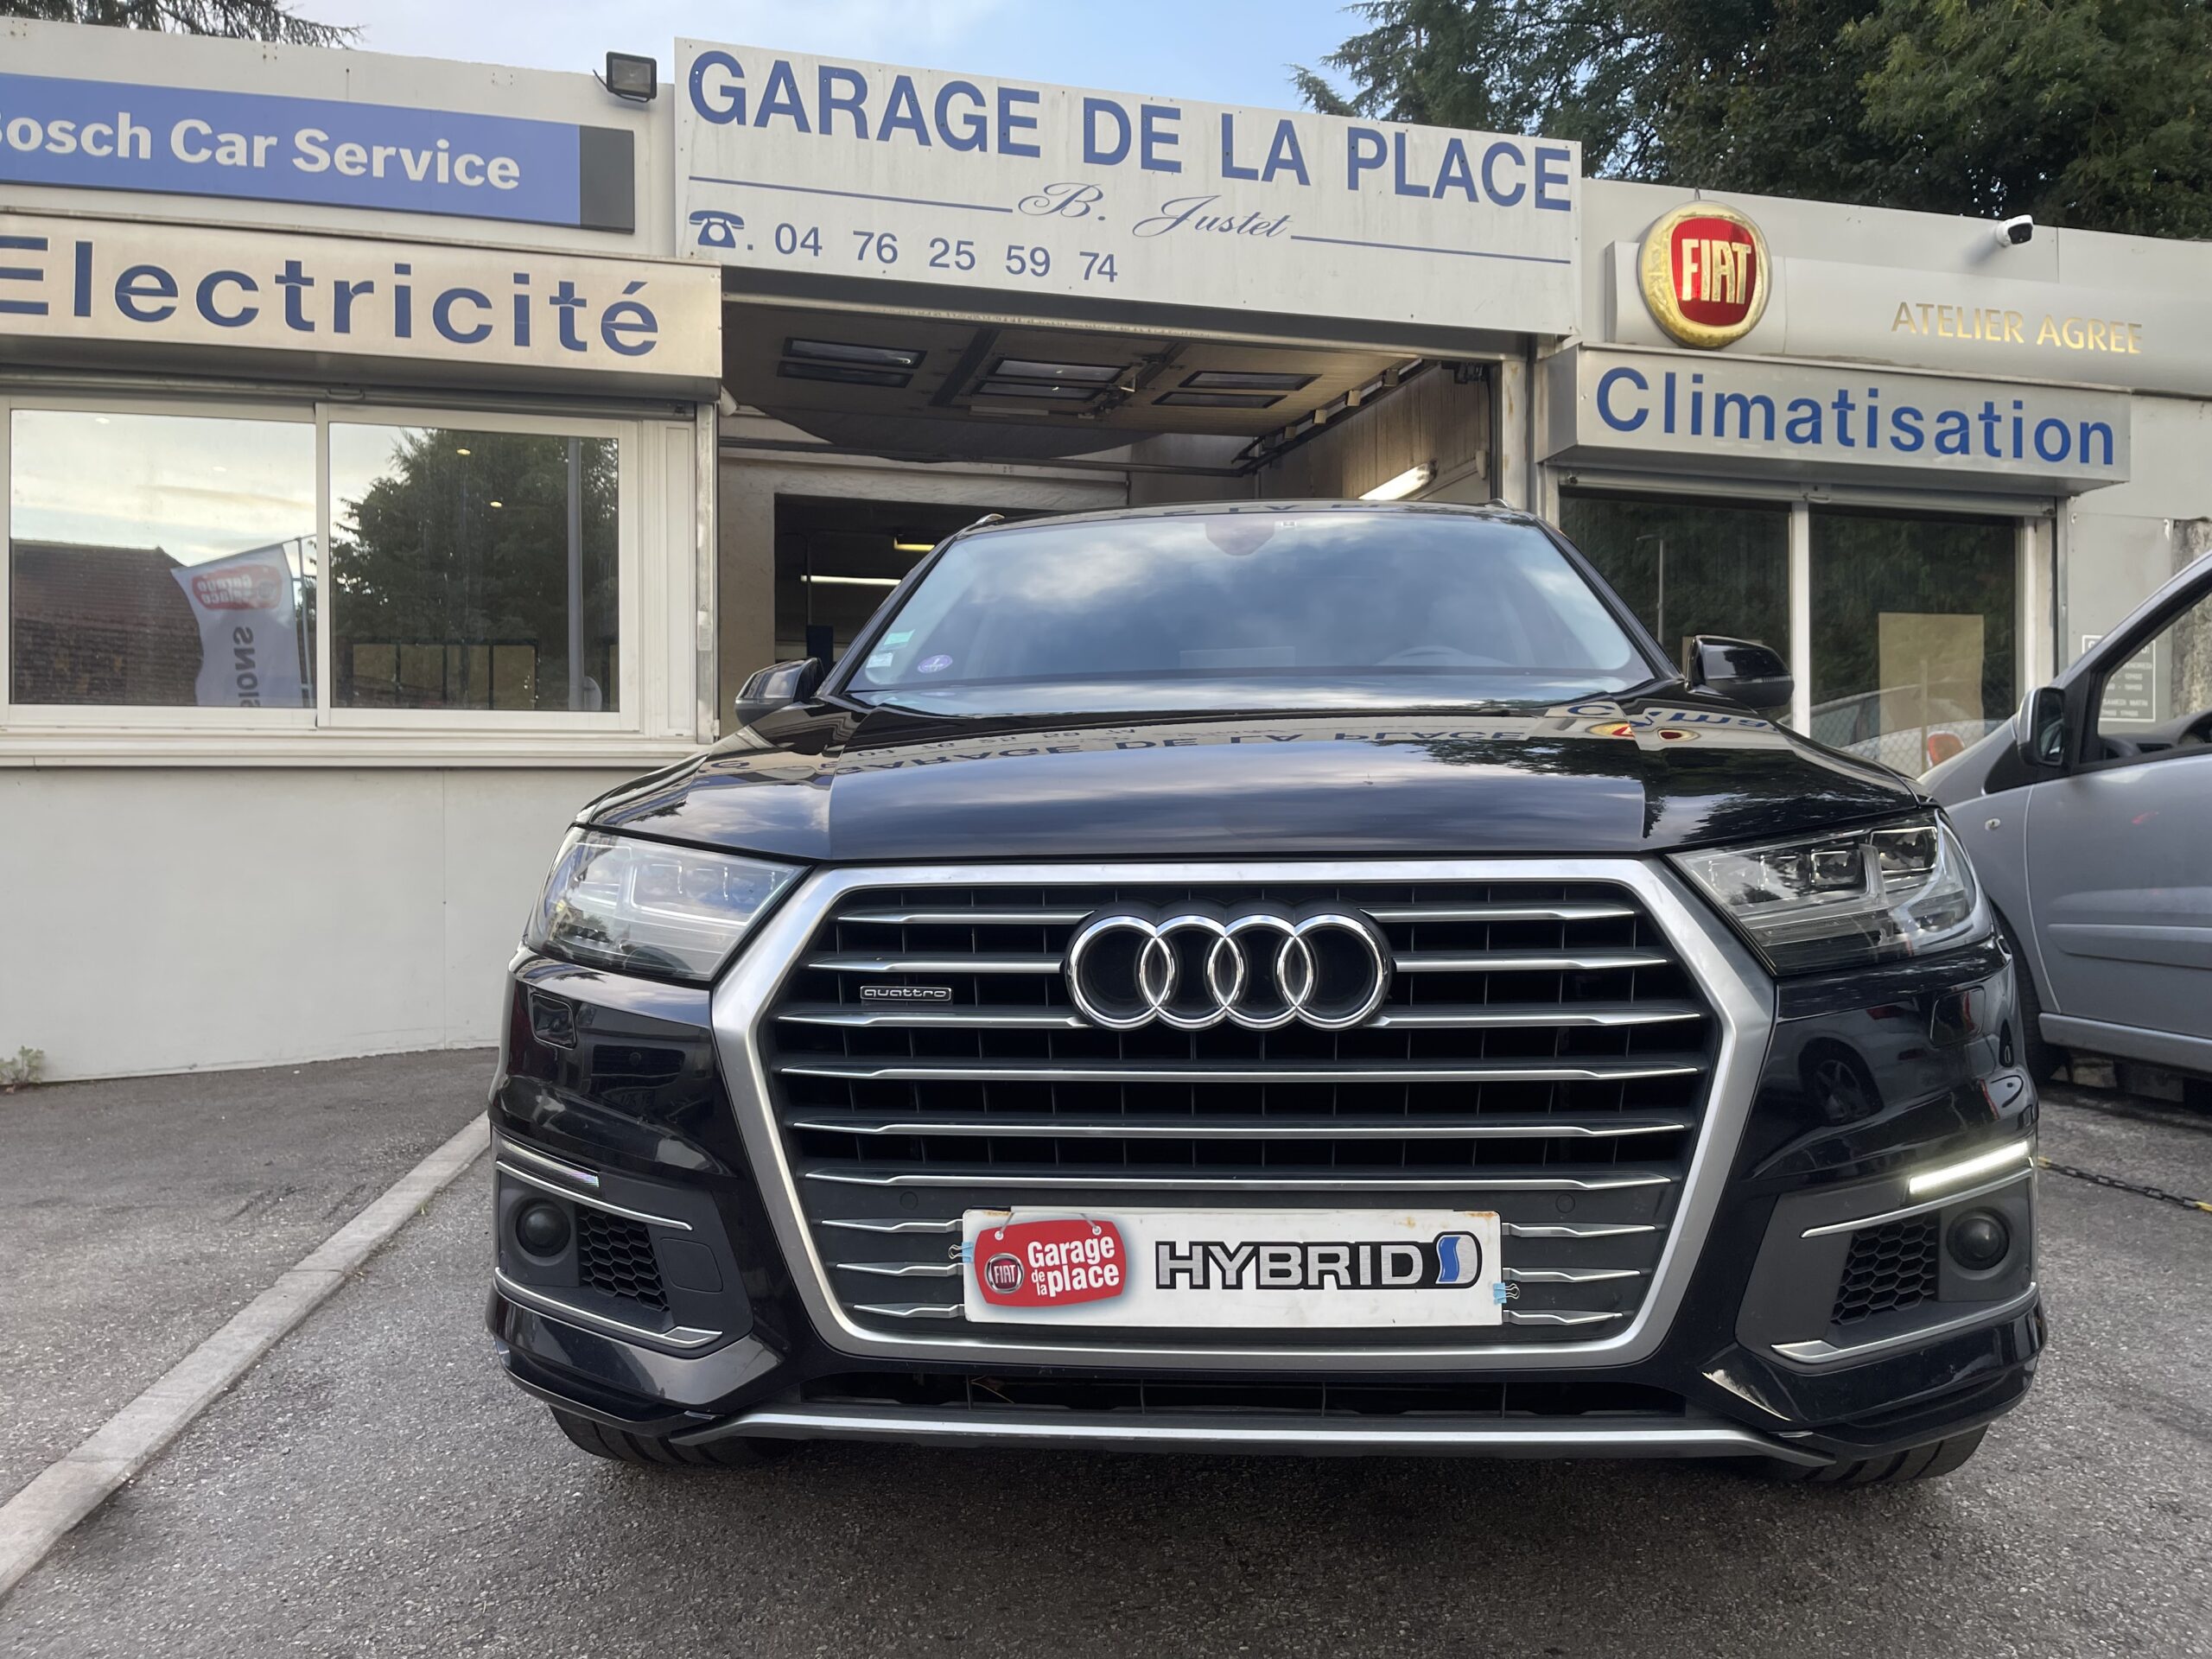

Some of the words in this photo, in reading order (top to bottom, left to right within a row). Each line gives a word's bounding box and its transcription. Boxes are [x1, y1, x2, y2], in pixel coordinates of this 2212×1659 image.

[0, 112, 152, 159] osch
[171, 118, 278, 168] Car
[292, 128, 521, 191] Service
[689, 50, 1041, 158] GARAGE
[1083, 97, 1182, 174] DE
[1221, 113, 1311, 186] LA
[1347, 126, 1572, 212] PLACE
[1018, 182, 1106, 221] B.
[1132, 194, 1294, 238] Justet
[774, 222, 823, 257] 04
[853, 230, 899, 264] 76
[928, 237, 976, 270] 25
[1005, 245, 1052, 277] 59
[1078, 251, 1118, 283] 74
[1681, 237, 1753, 305] FIAT
[1891, 301, 2025, 345] ATELIER
[2036, 314, 2143, 355] AGREE
[1596, 365, 2115, 467] Climatisation
[864, 988, 947, 997] quattro
[994, 1264, 1017, 1285] FIAT
[1027, 1235, 1116, 1268] Garage
[1157, 1242, 1425, 1288] HYBRID
[1031, 1268, 1046, 1284] de
[1046, 1263, 1121, 1298] place
[1037, 1282, 1048, 1296] la
